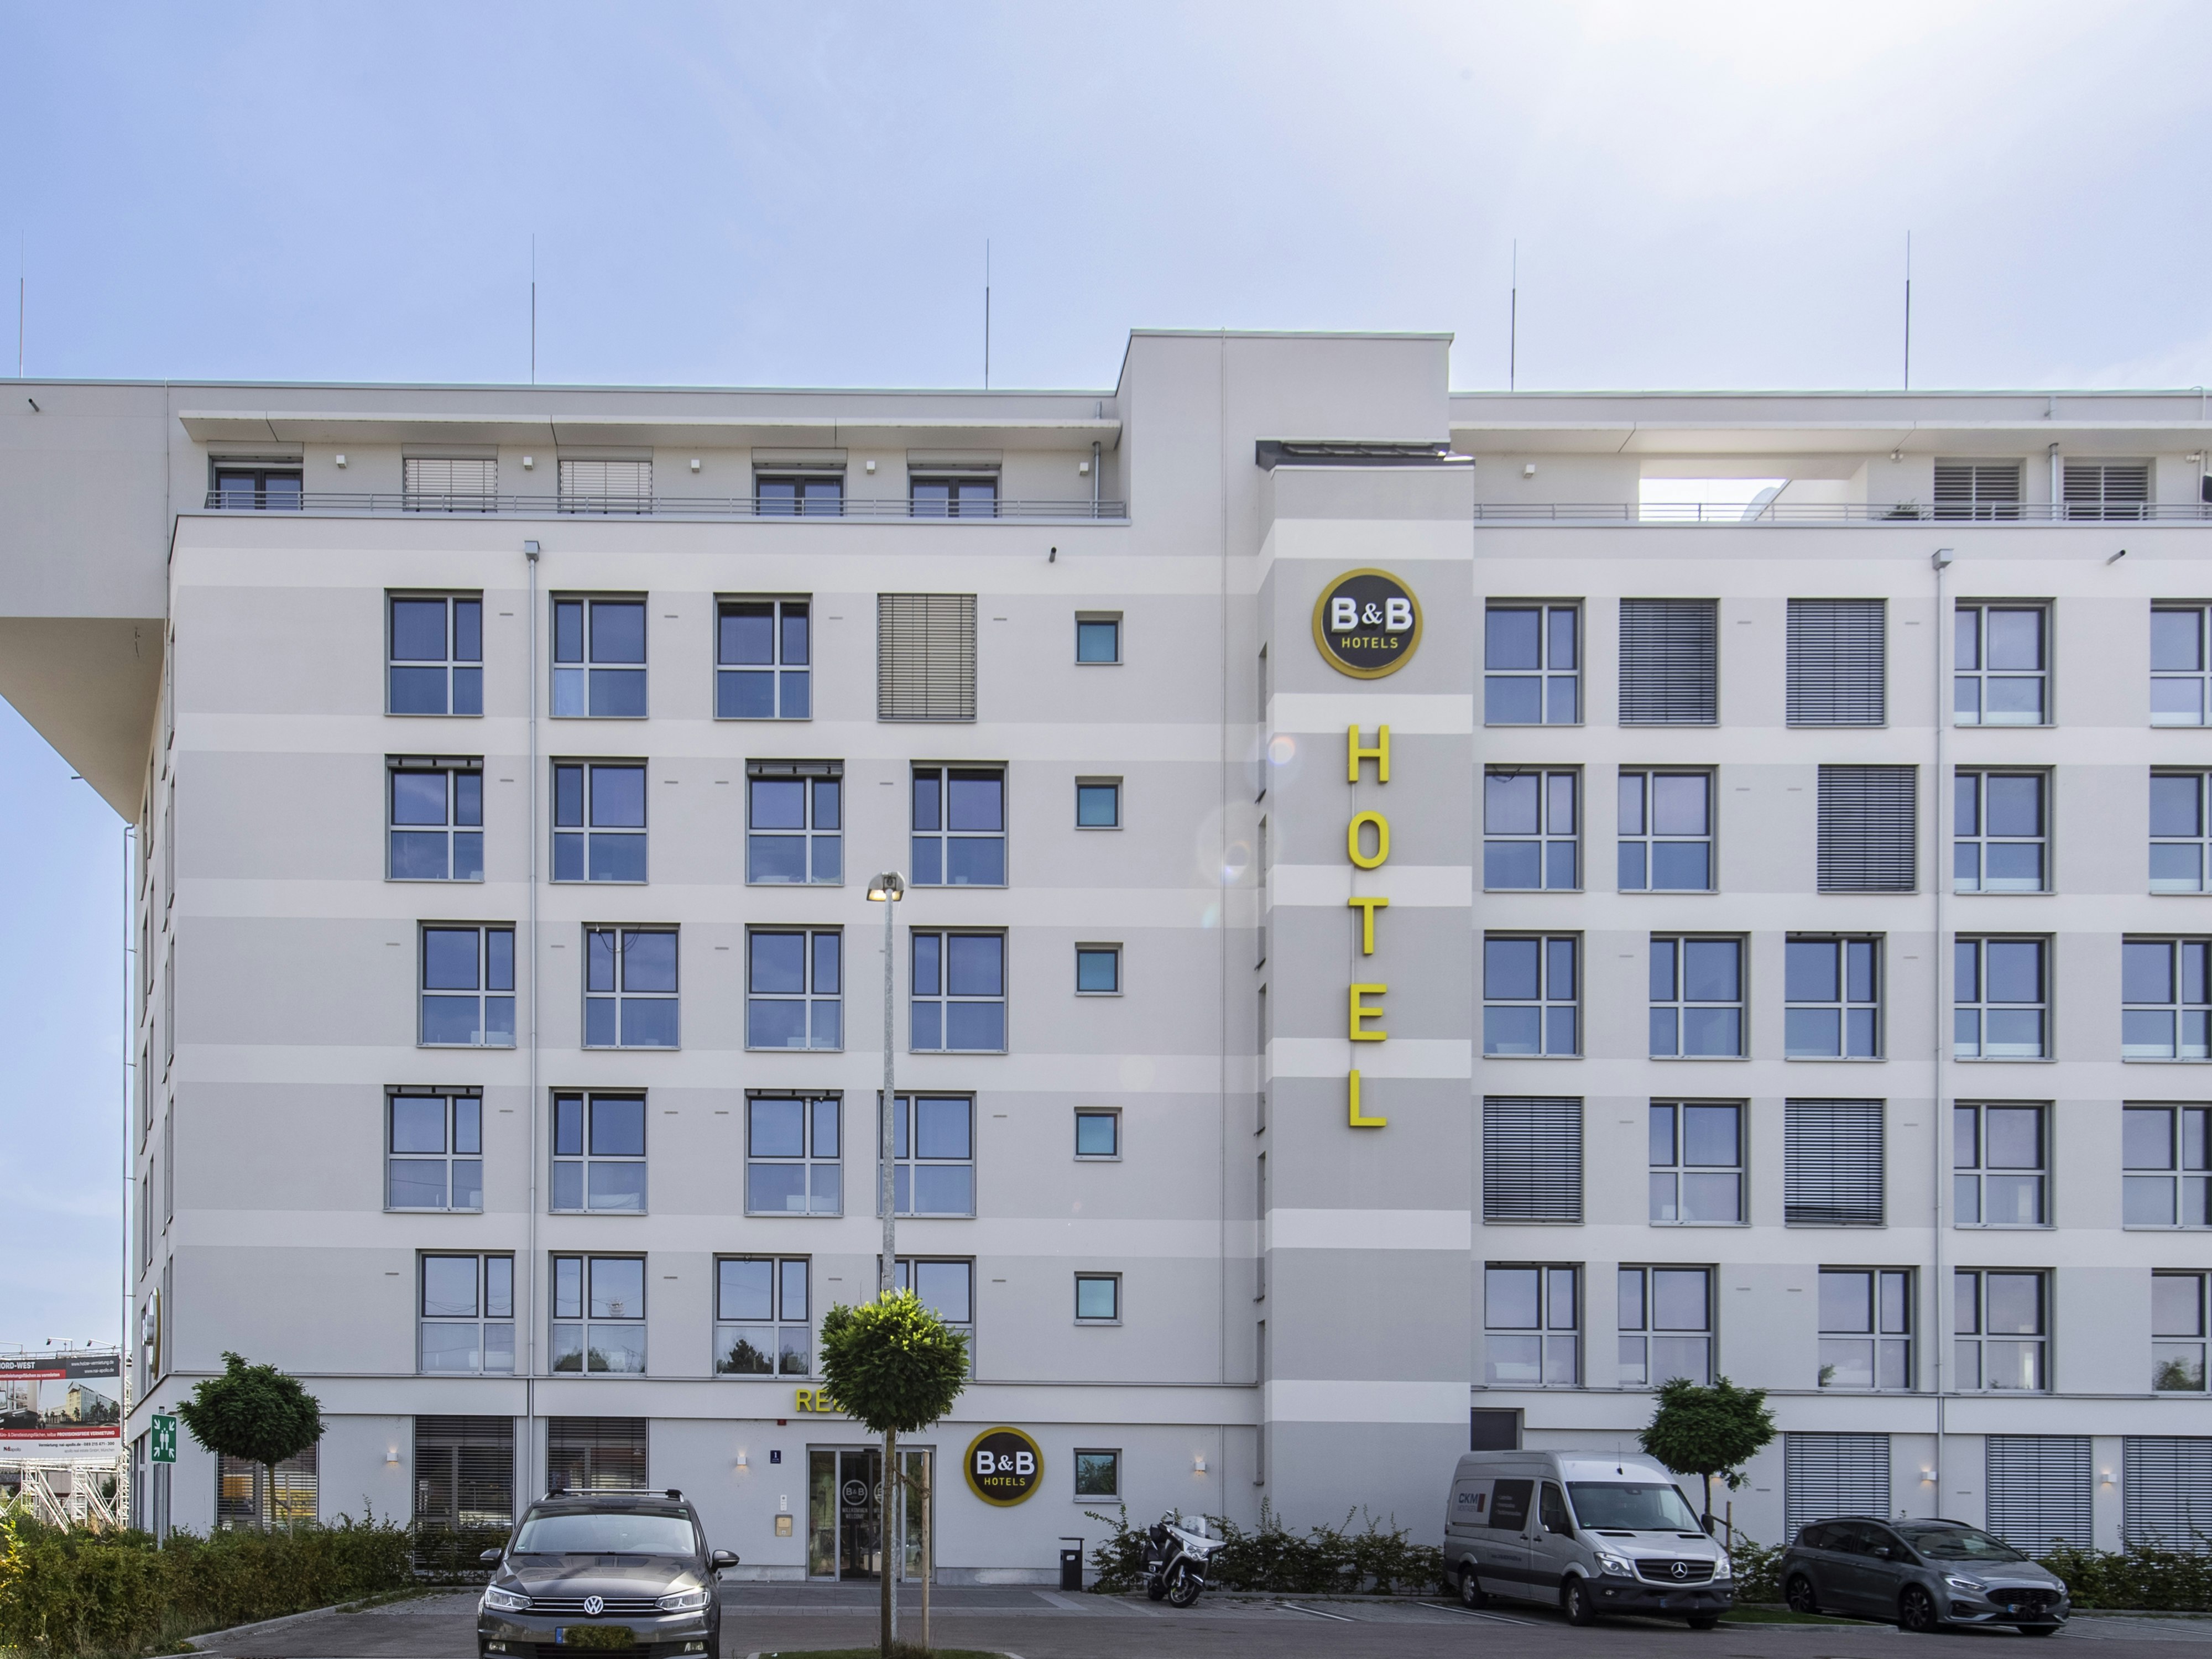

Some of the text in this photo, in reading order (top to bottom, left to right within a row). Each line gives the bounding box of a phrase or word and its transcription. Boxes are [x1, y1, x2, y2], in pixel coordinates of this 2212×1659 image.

[1331, 597, 1412, 633] B&B
[1342, 637, 1398, 648] HOTELS
[1348, 724, 1389, 1126] HOTEL
[977, 1451, 1035, 1475] B&B
[984, 1478, 1025, 1486] HOTELS
[1459, 1493, 1478, 1504] CKM
